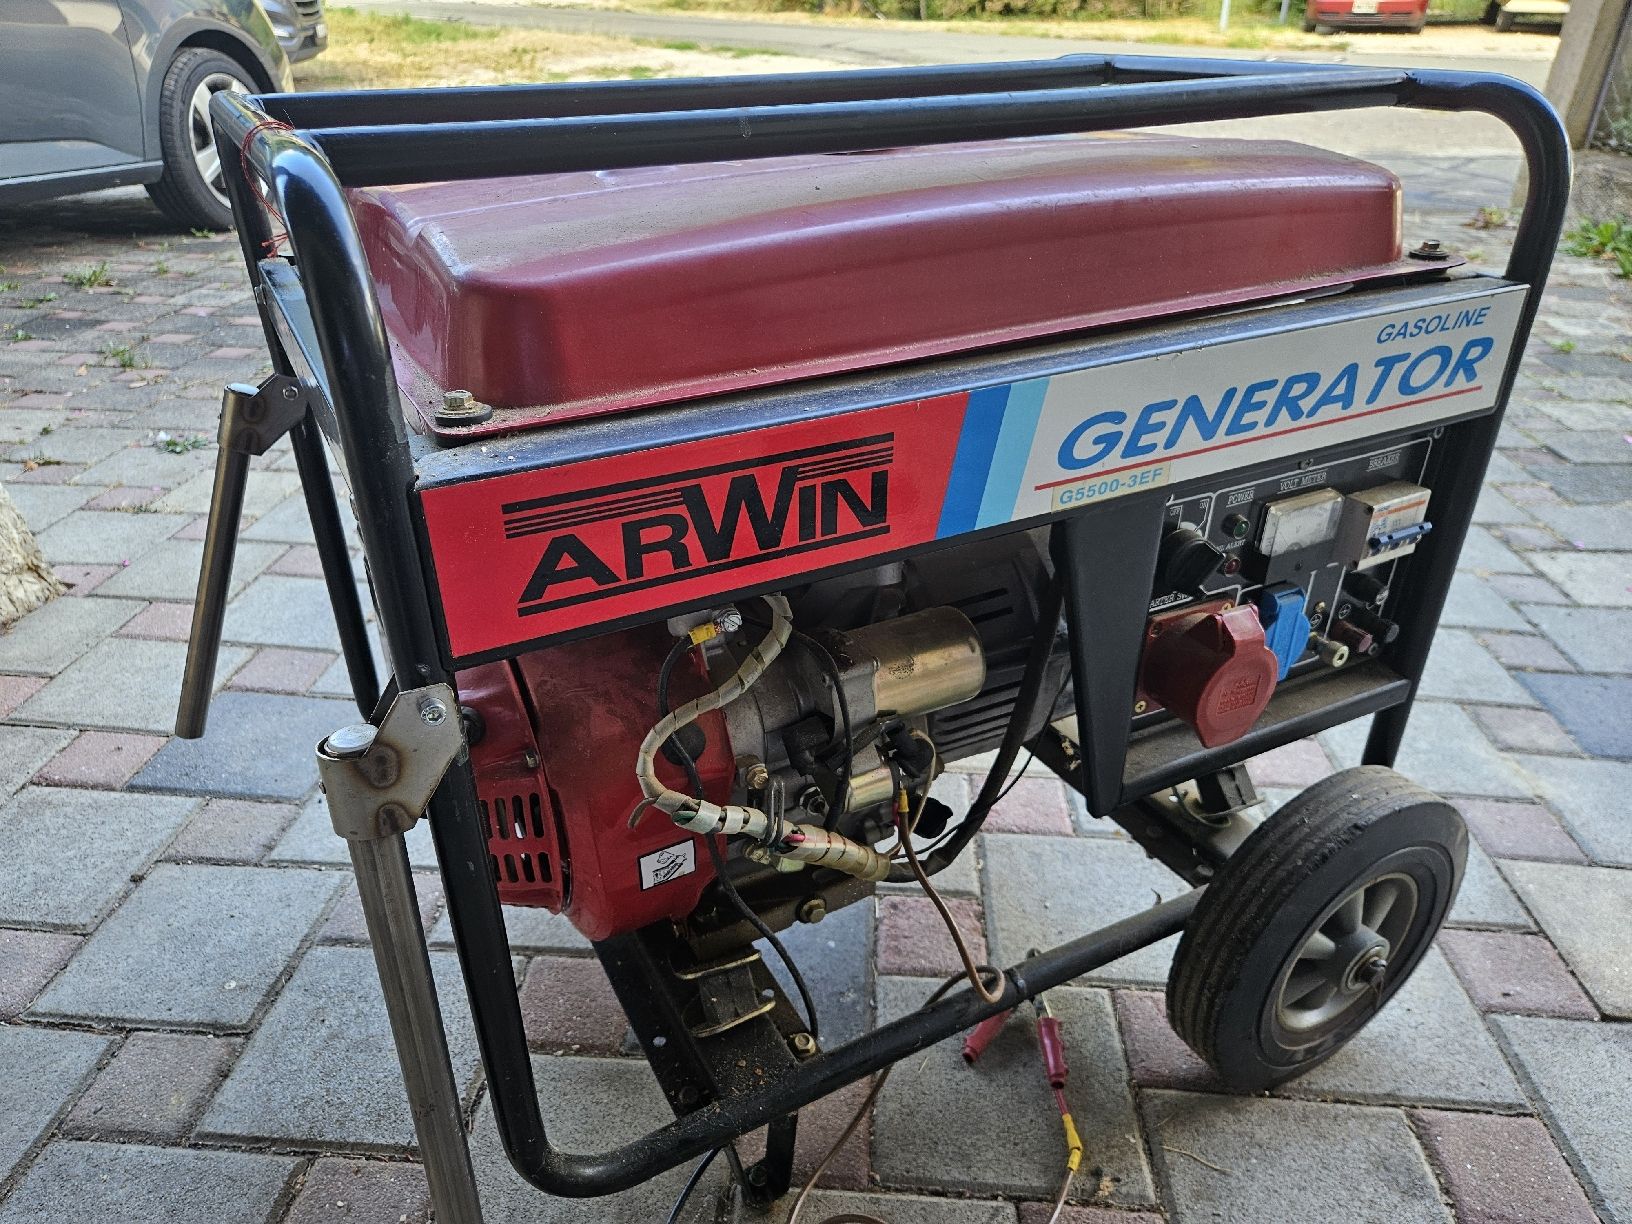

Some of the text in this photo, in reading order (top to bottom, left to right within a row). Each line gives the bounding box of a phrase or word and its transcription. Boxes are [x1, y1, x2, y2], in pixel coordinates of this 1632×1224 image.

[1376, 306, 1491, 344] GASOLINE
[1057, 336, 1495, 471] GENERATOR
[1059, 467, 1164, 505] G5500-3EF
[1227, 490, 1255, 505] POWER
[1279, 471, 1327, 491] VOLT METER
[517, 466, 890, 605] ARWIN
